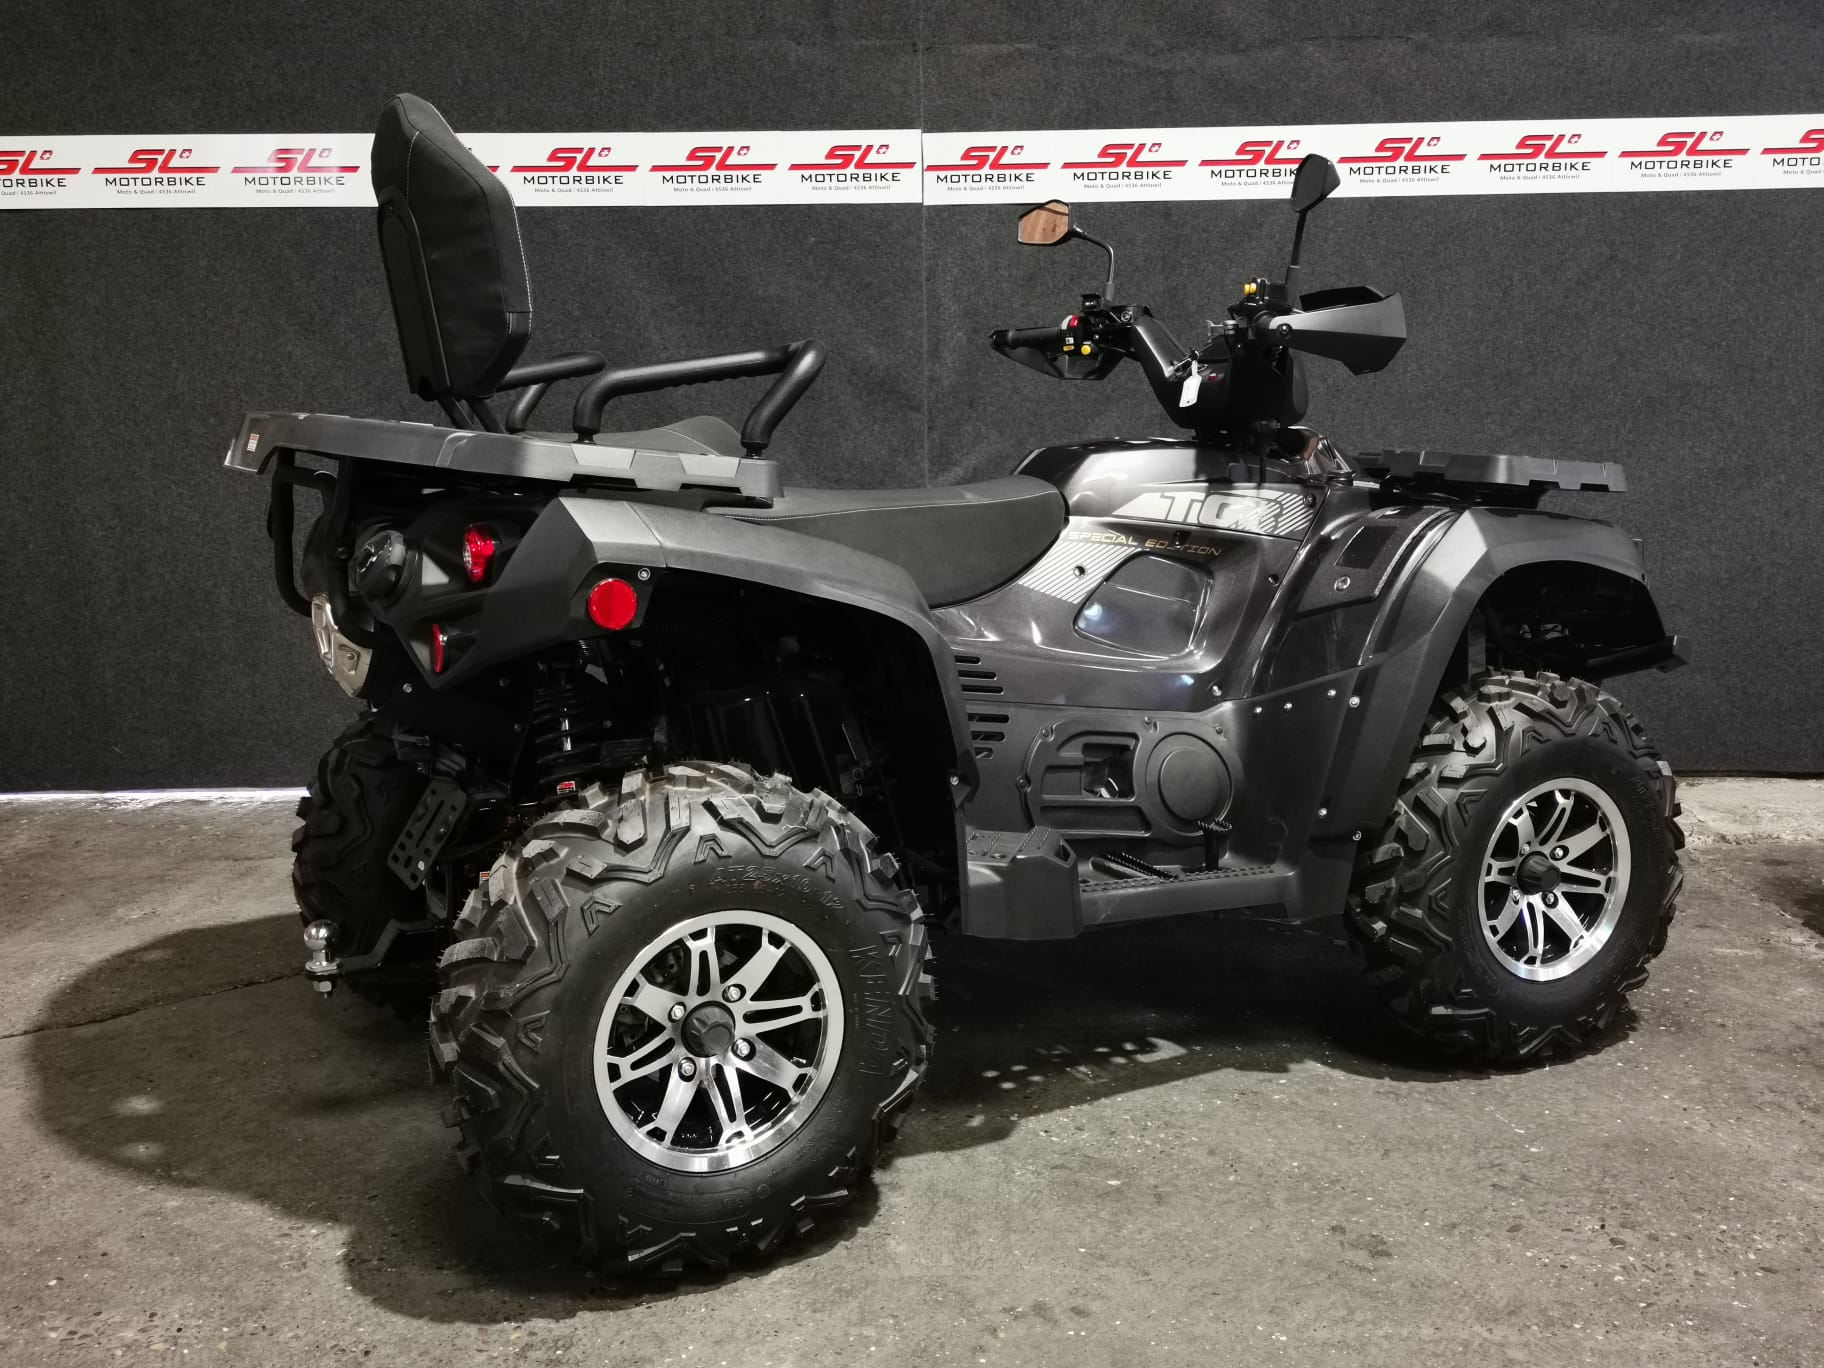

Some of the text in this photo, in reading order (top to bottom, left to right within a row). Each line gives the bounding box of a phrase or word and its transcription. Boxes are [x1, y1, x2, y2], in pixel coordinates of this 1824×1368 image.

[1489, 161, 1591, 173] MOTORBIKE
[1630, 159, 1732, 170] MOTORBIKE
[1772, 156, 1824, 167] MOTO
[1073, 170, 1173, 181] MOTORBIKE
[1210, 167, 1297, 179] MOTORBIK
[1349, 164, 1450, 176] MOTORBIKE
[0, 177, 67, 188] ORBIKE
[105, 176, 206, 187] MOTORBIKE
[244, 175, 346, 186] MOTORBIKE
[523, 175, 624, 185] MOTORBIKE
[662, 173, 762, 185] MOTORBIKE
[800, 172, 901, 183] MOTORBIKE
[936, 172, 1035, 184] MOTORBIKE
[1066, 530, 1139, 546] SPECIAL
